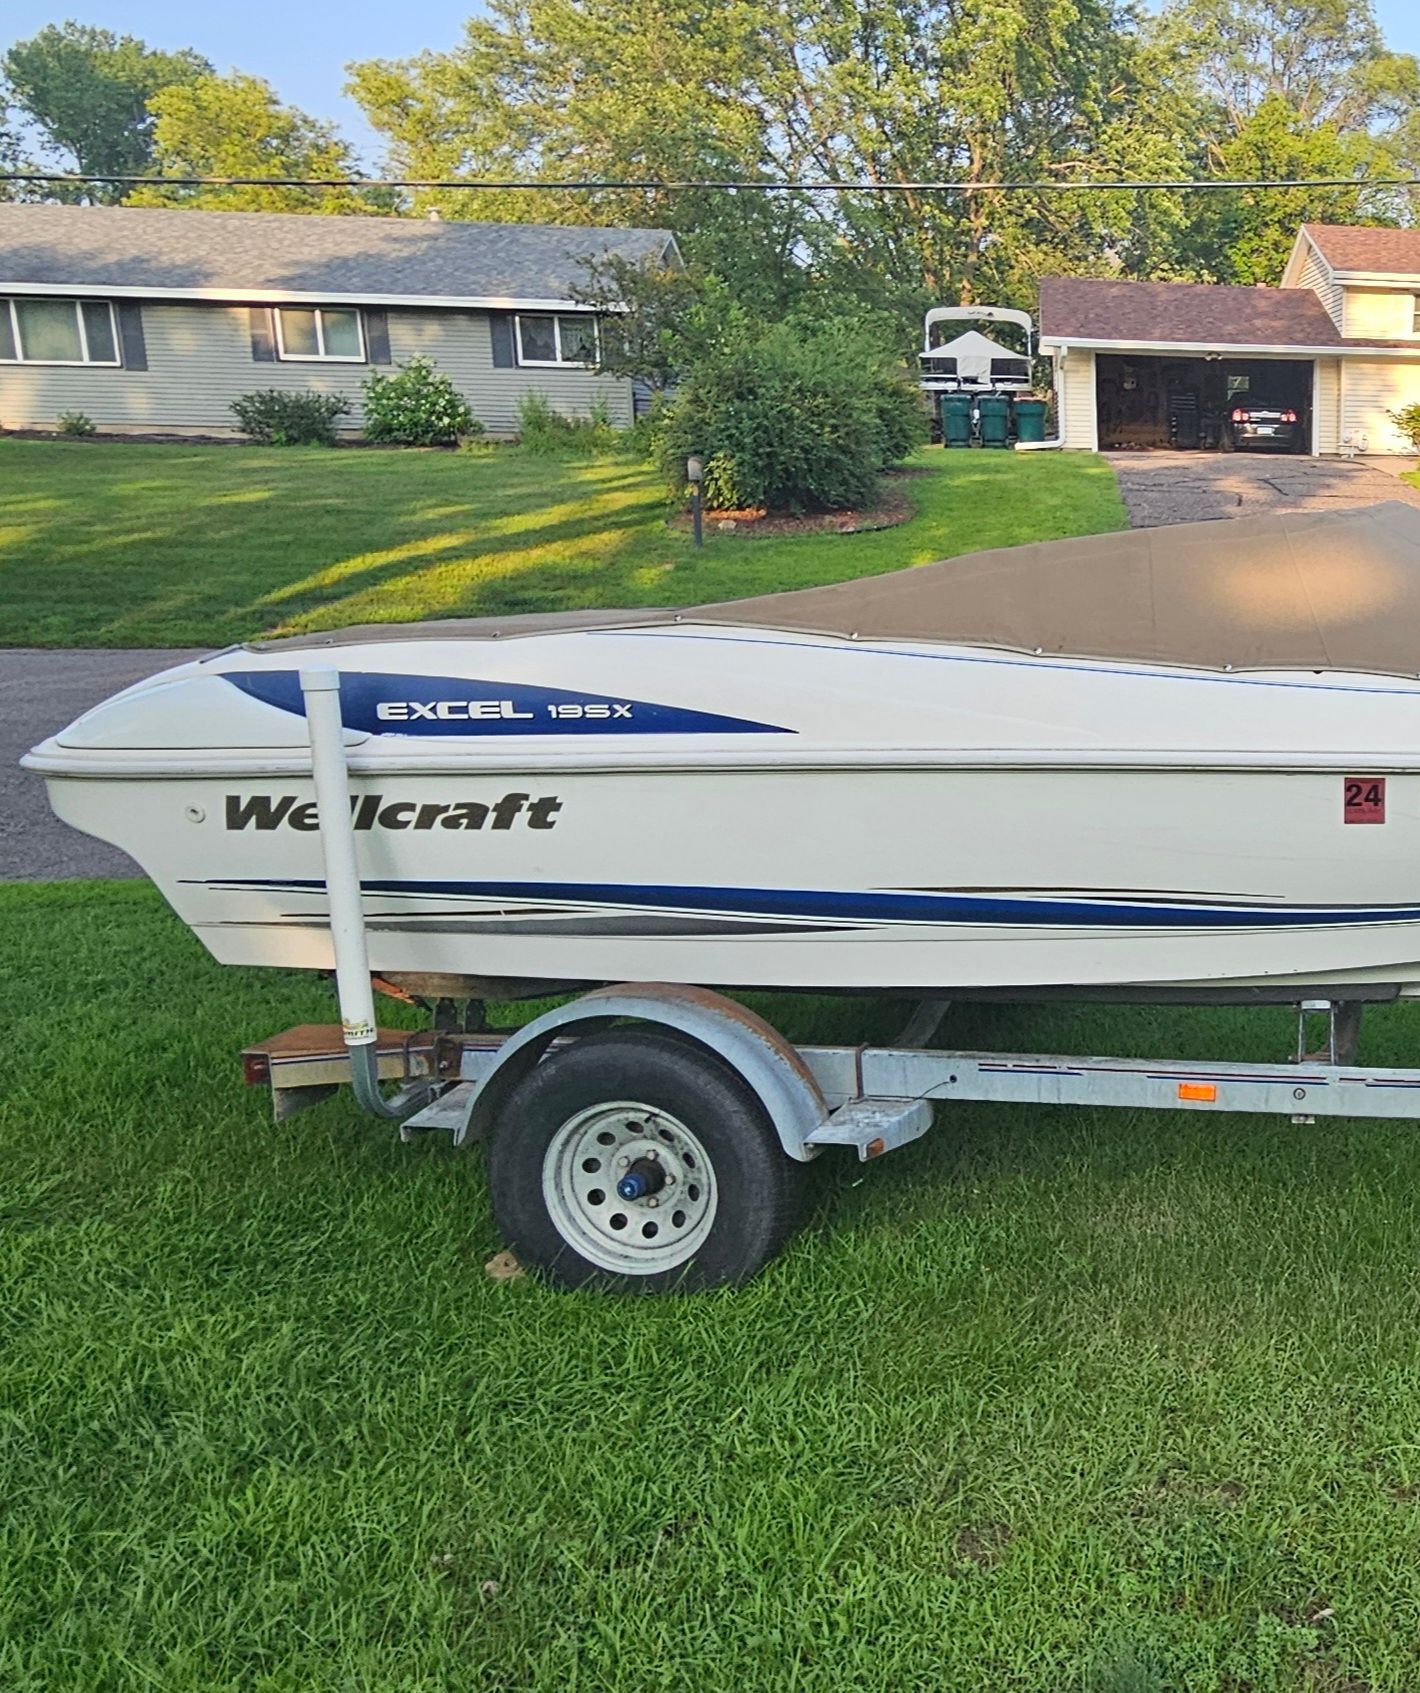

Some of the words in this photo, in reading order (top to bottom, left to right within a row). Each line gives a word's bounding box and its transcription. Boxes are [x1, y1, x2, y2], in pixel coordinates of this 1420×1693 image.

[376, 701, 534, 720] EXCEL
[547, 704, 633, 719] 19SX
[1346, 784, 1382, 807] 24
[225, 792, 563, 832] Welcraft
